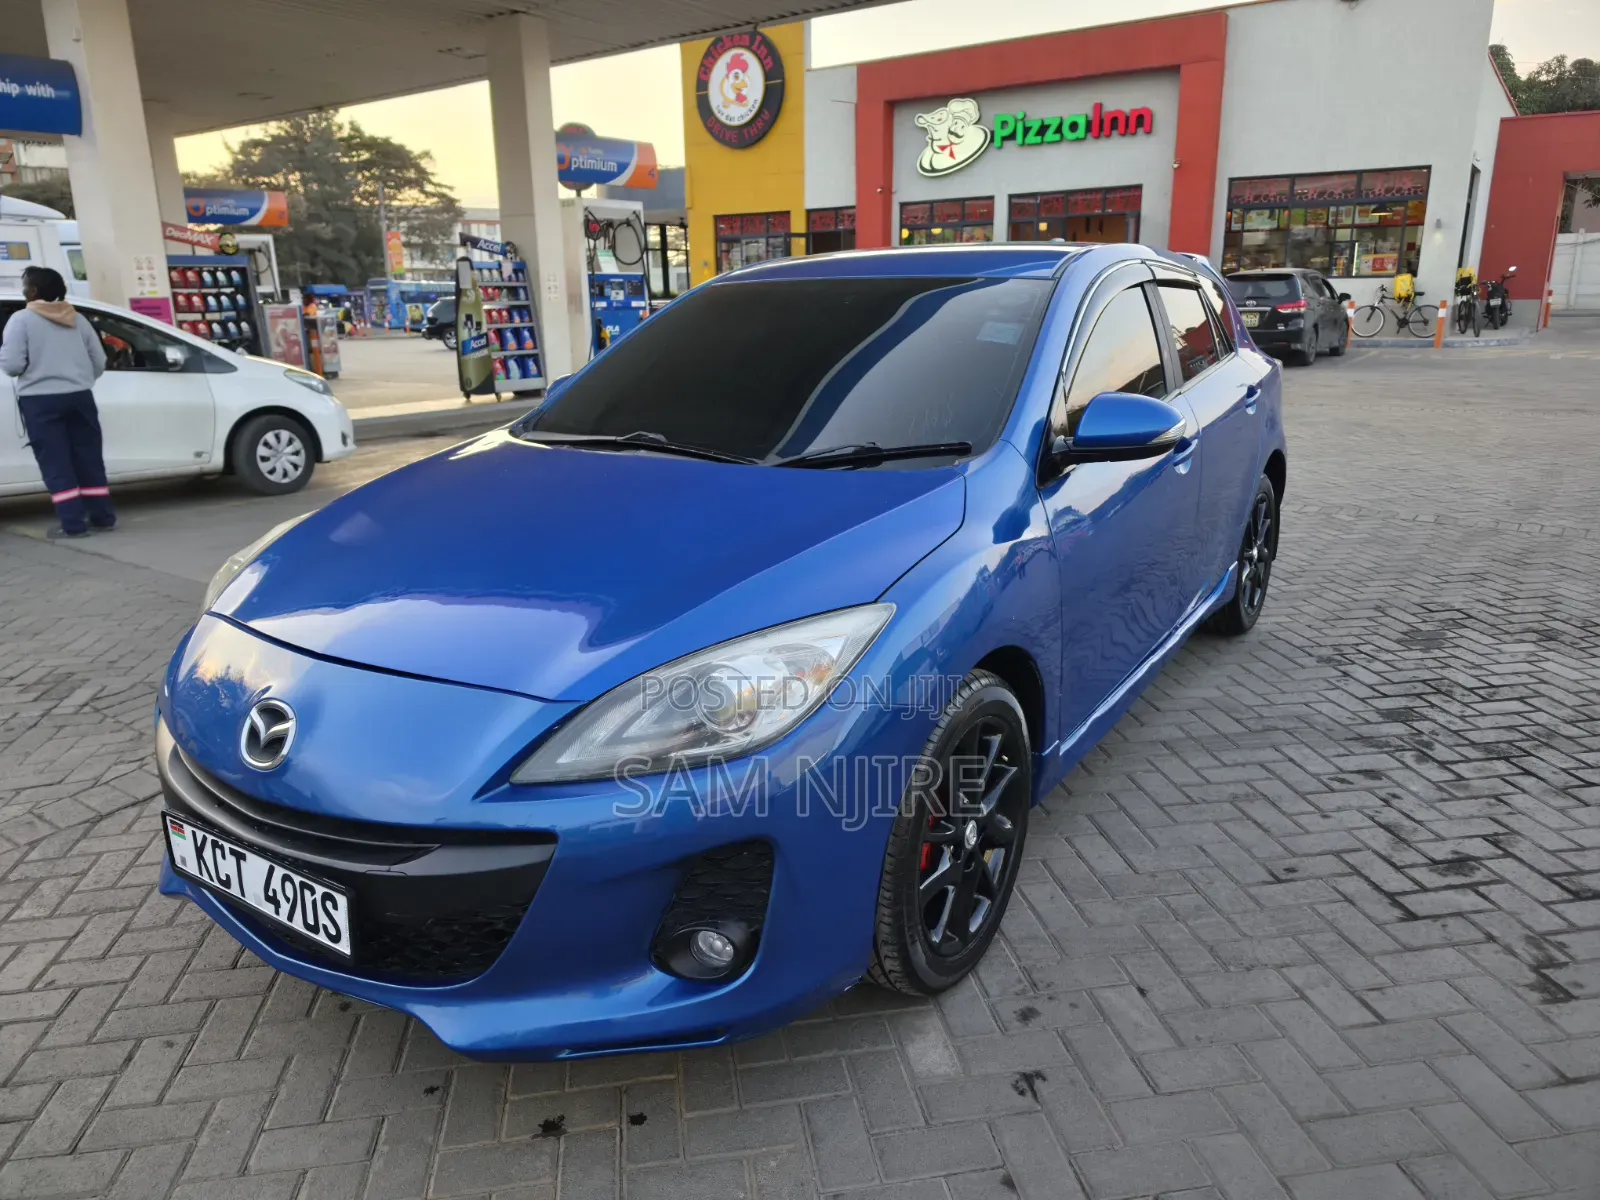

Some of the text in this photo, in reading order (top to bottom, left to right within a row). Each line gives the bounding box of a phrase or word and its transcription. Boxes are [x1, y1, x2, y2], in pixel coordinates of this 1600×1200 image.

[699, 34, 775, 81] Chicken Inn
[24, 81, 55, 99] with
[707, 108, 771, 143] DRIVE THRU
[993, 102, 1154, 149] Pizza Inn
[476, 239, 502, 252] Accel
[469, 335, 487, 350] Accel
[192, 829, 247, 899] KCT
[263, 864, 342, 945] 490S
